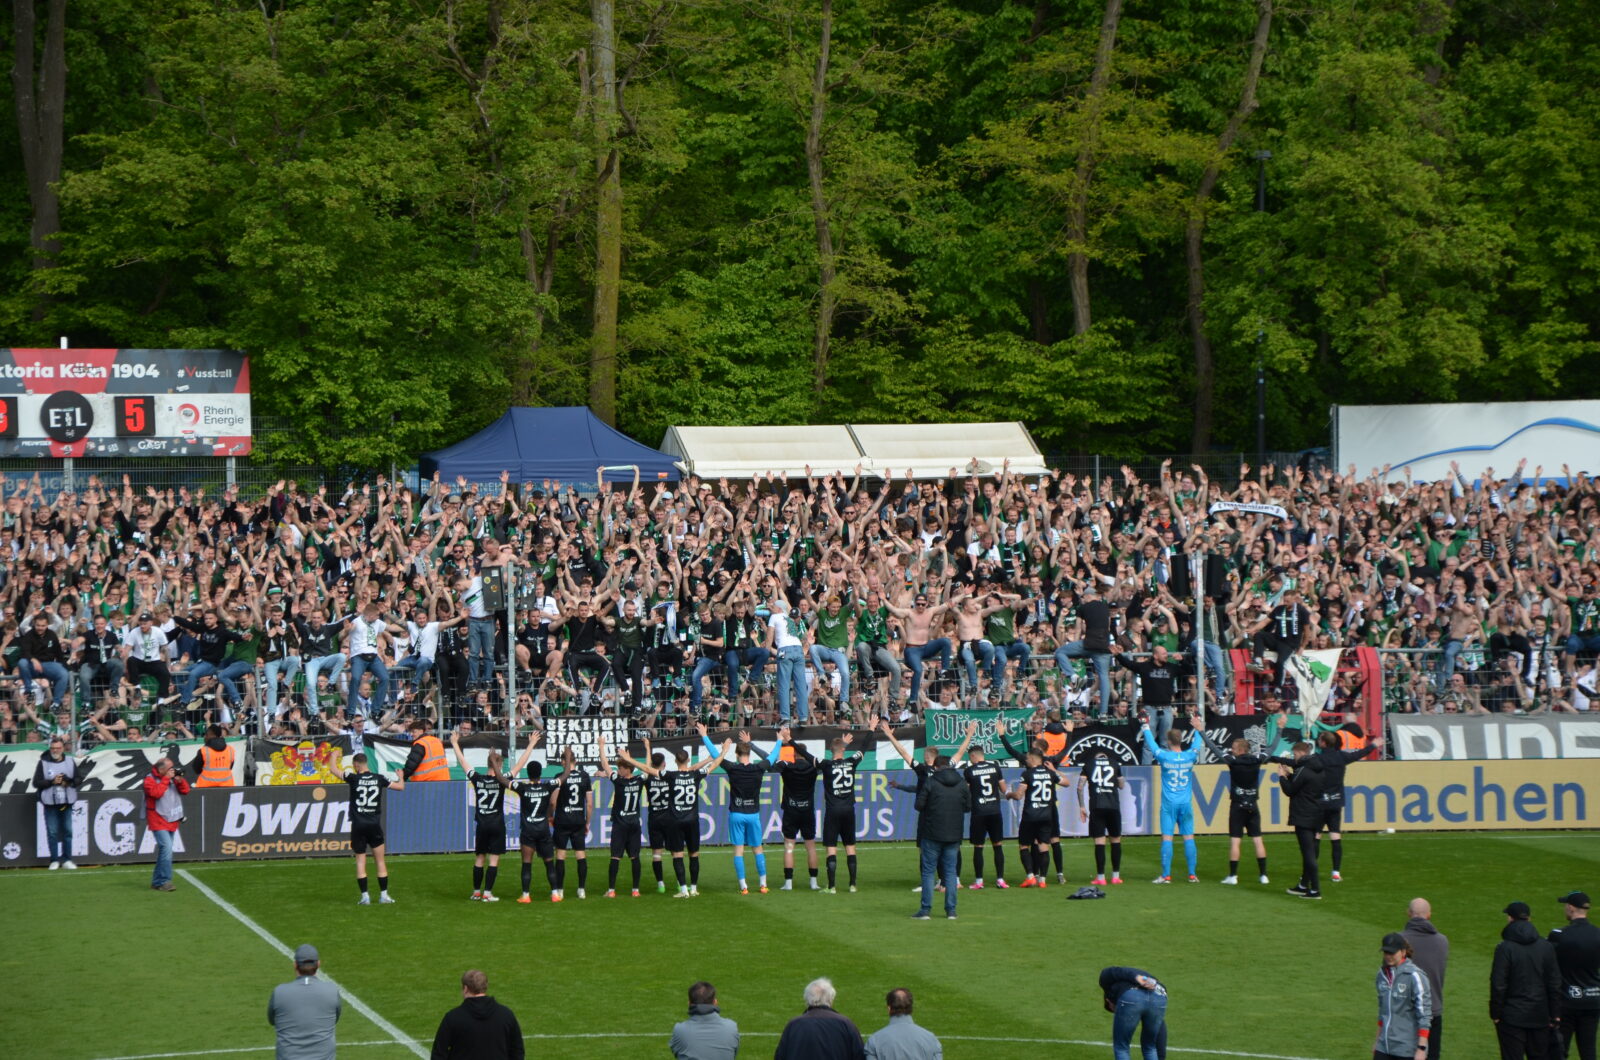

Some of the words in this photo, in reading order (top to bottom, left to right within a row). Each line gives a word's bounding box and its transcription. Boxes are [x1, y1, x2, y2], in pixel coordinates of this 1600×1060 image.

[112, 363, 160, 378] 1904
[124, 398, 145, 432] 5
[204, 405, 234, 415] Rhein
[204, 415, 244, 427] Energie
[137, 441, 168, 450] GAST
[546, 718, 629, 731] SEKTION
[546, 730, 629, 744] STADION
[832, 766, 854, 789] 25
[980, 775, 993, 796] 5
[1091, 766, 1115, 787] 42
[1167, 769, 1189, 788] 35
[355, 785, 380, 807] 32
[477, 788, 500, 810] 27
[568, 784, 580, 805] 3
[673, 784, 697, 805] 28
[1031, 780, 1052, 802] 26
[1344, 765, 1587, 824] machen
[221, 787, 353, 838] bwin
[530, 797, 542, 818] 7
[623, 792, 640, 812] 11
[221, 838, 353, 857] Sportwetten
